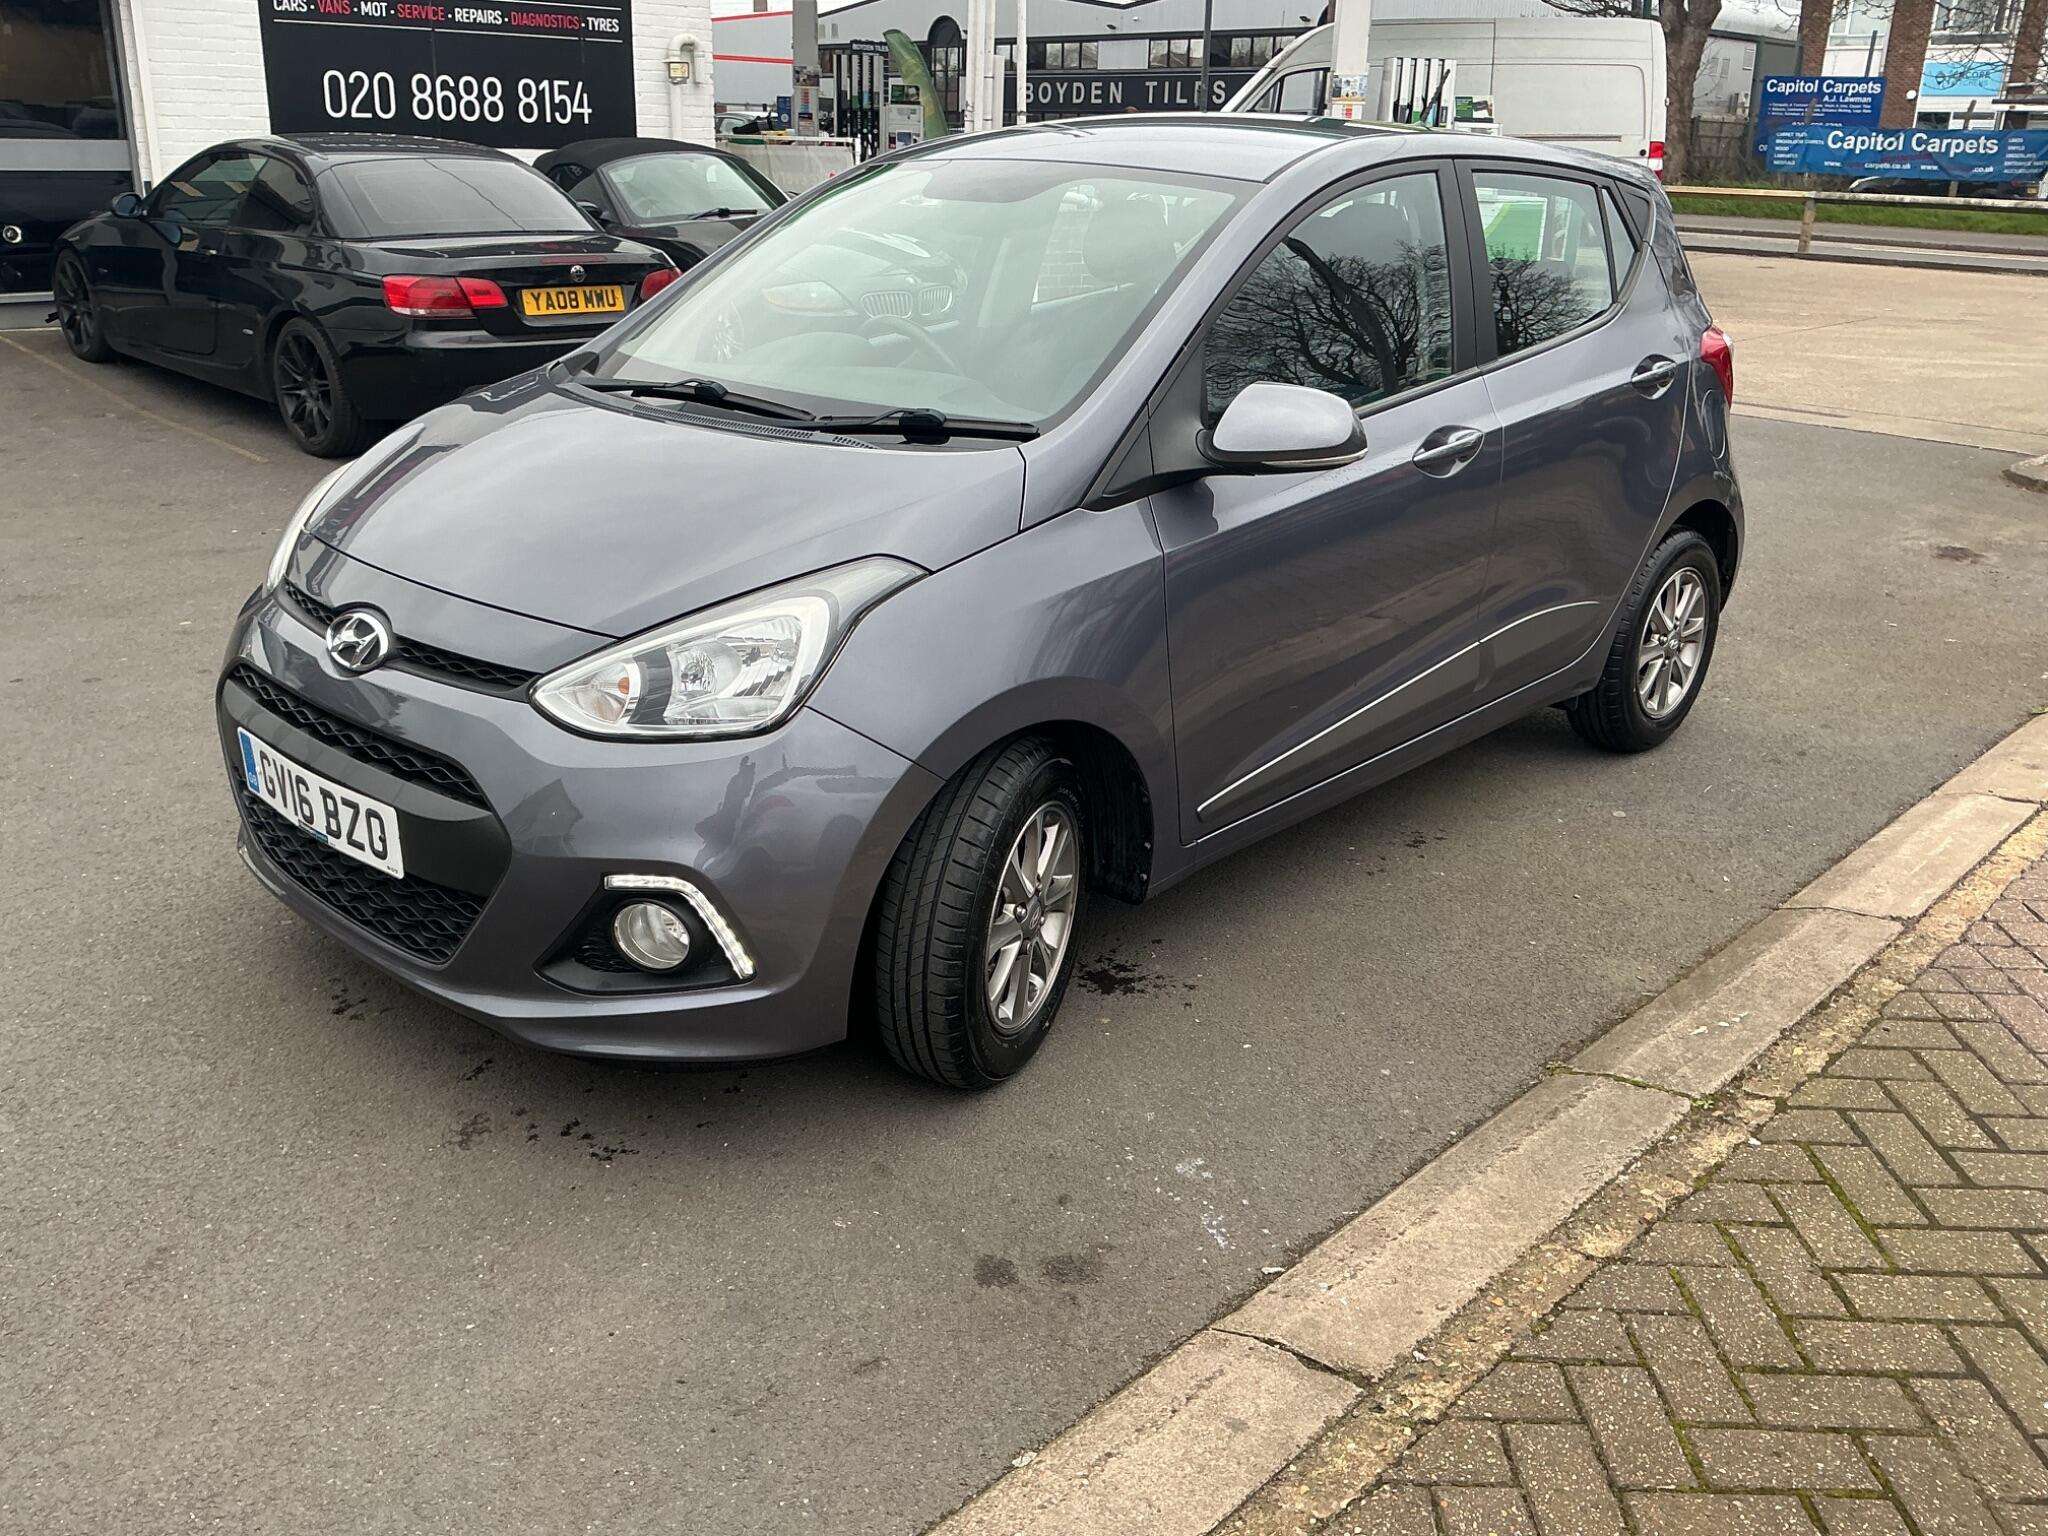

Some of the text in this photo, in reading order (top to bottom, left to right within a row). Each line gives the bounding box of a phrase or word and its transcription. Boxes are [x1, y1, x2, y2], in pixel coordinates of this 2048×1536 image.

[273, 0, 620, 32] CARS VANS MOT SERVICE REPAIRS DIAGNOSTICS TYRES
[322, 69, 593, 125] 020 8688 8154
[1026, 81, 1123, 105] BOYDEN
[1766, 79, 1882, 96] Capitol Carpets
[1827, 130, 1999, 158] Capitol Carpets
[530, 289, 580, 311] YA08
[259, 750, 315, 826] GV16
